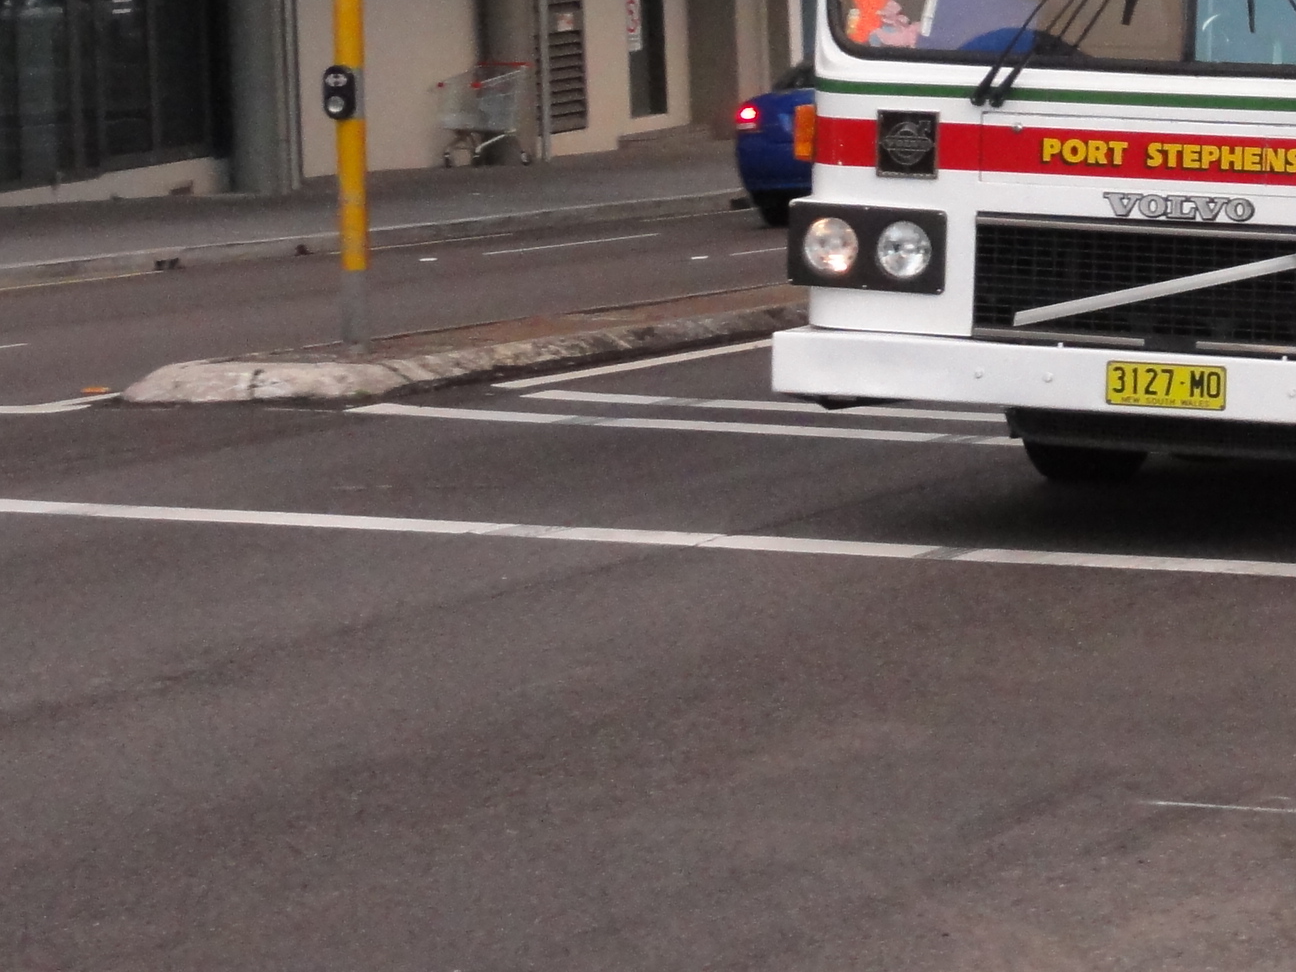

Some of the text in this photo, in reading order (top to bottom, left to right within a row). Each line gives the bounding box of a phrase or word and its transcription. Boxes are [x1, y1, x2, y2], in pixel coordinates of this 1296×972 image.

[1041, 138, 1128, 166] PORT
[1103, 192, 1256, 222] VOLVO
[1145, 397, 1176, 406] SOUTH
[1180, 399, 1210, 408] WALES
